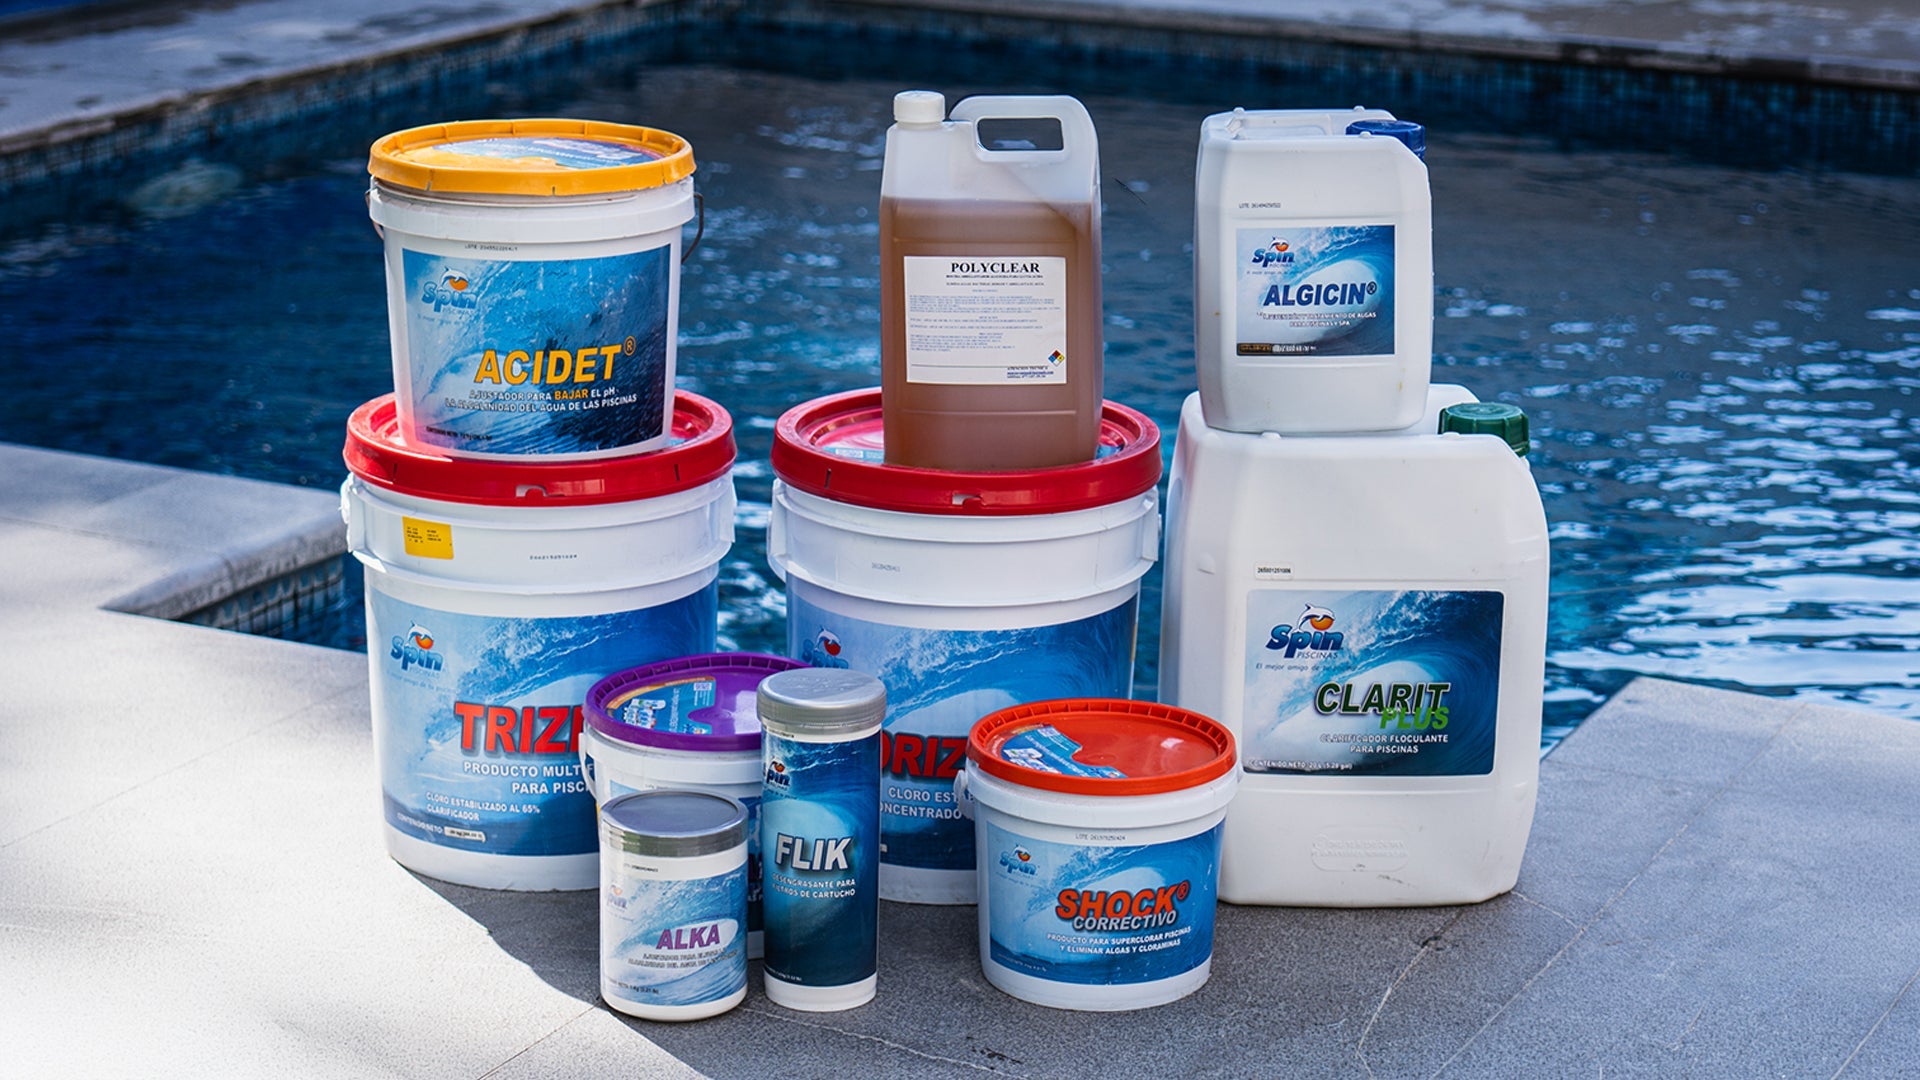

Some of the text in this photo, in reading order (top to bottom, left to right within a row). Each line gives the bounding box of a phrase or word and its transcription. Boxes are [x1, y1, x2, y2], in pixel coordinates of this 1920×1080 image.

[951, 262, 1041, 273] POLYCLEAR
[1252, 248, 1295, 268] Spin
[421, 281, 479, 313] Spin
[469, 386, 615, 401] AJUSTADOR PARA BAJAR EL pH
[518, 403, 537, 413] DEL
[539, 402, 566, 412] AGUA
[568, 401, 581, 411] DE
[582, 400, 600, 410] LAS
[601, 393, 638, 408] PISCINAS
[1265, 623, 1344, 659] Spin
[390, 635, 444, 672] Spin
[1296, 651, 1338, 659] PISCINAS
[1315, 681, 1451, 716] CLARIT
[1379, 705, 1450, 731] PLUS
[1319, 733, 1449, 744] CLARIFICADOR FLOCULANTE
[1350, 744, 1419, 754] PARA PISCINAS
[463, 761, 595, 778] PRODUCTO MULTF
[511, 782, 549, 794] PARA
[888, 786, 960, 803] CLORO EST
[426, 791, 541, 814] CLORO ESTABILIZADO AL 65%
[426, 803, 480, 821] CLARIFICADOR
[774, 831, 854, 871] FLIK
[999, 851, 1037, 876] Spin
[772, 871, 856, 889] DESENGRASANTE PARA
[800, 890, 811, 898] DE
[812, 888, 856, 898] CARTUCHO
[1072, 908, 1177, 932] CORRECTIVO
[655, 923, 721, 951] ALKA
[1047, 925, 1192, 946] PRODUCTO PARA SUPERCLORAR PISCINAS
[1067, 945, 1103, 955] ELIMINAR
[1105, 946, 1131, 955] ALGAS
[1132, 945, 1138, 953] Y
[1138, 938, 1181, 953] CLORAMINAS
